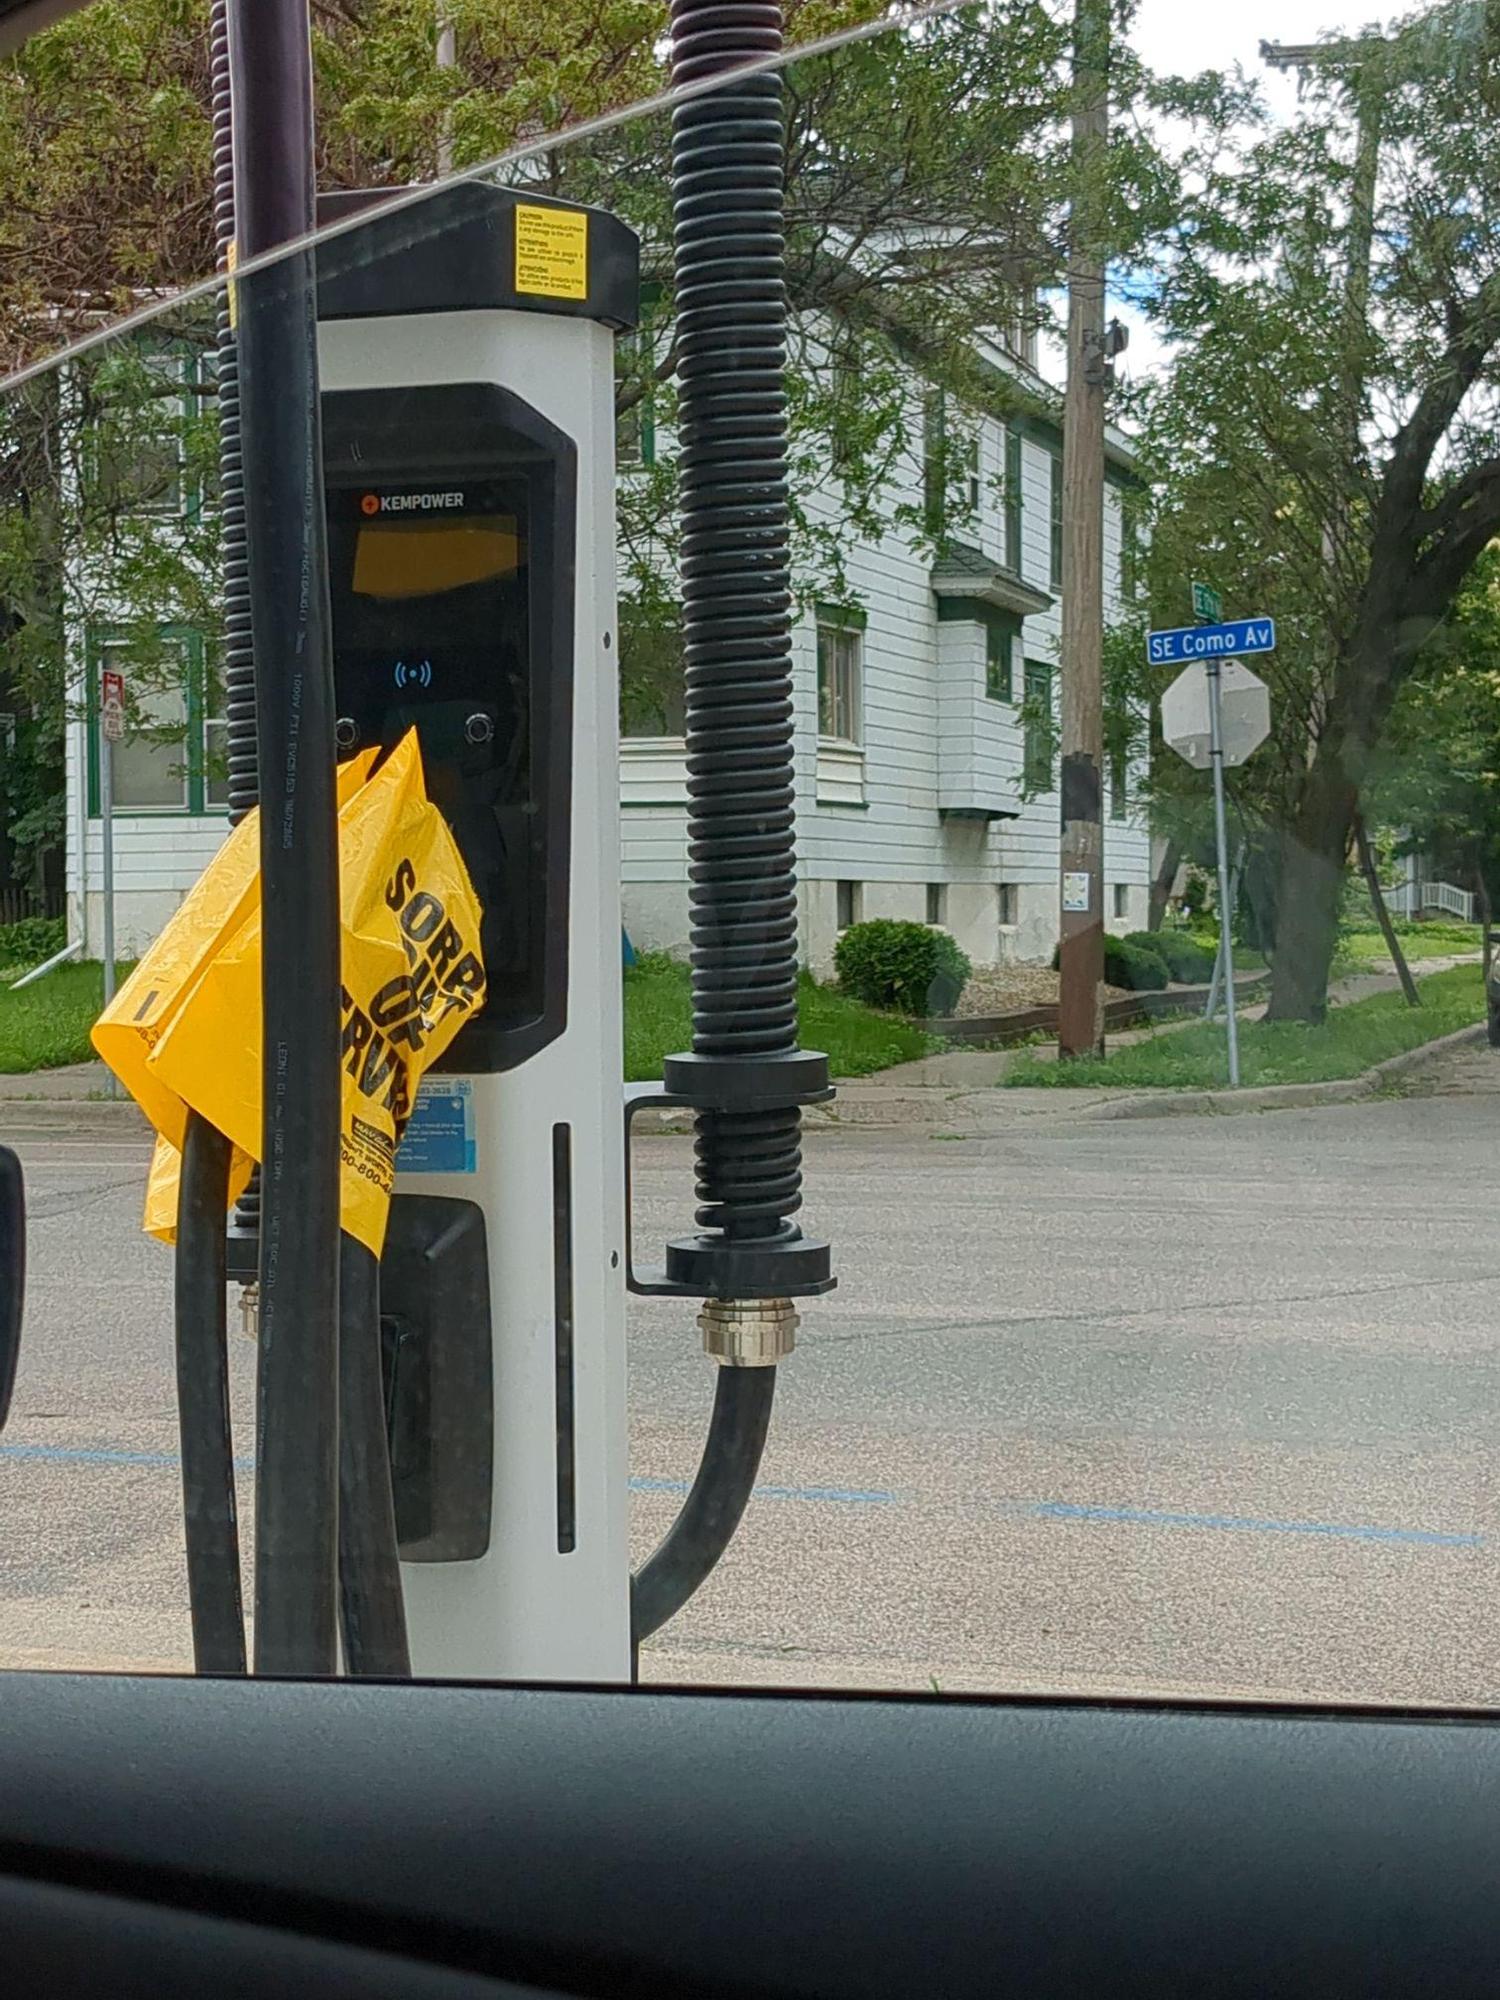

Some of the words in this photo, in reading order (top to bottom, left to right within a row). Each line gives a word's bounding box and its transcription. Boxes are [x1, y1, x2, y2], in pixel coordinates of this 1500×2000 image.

[380, 493, 464, 511] KEMPOWER
[1152, 636, 1174, 658] SE
[1182, 633, 1236, 654] Como
[1244, 626, 1269, 646] Av
